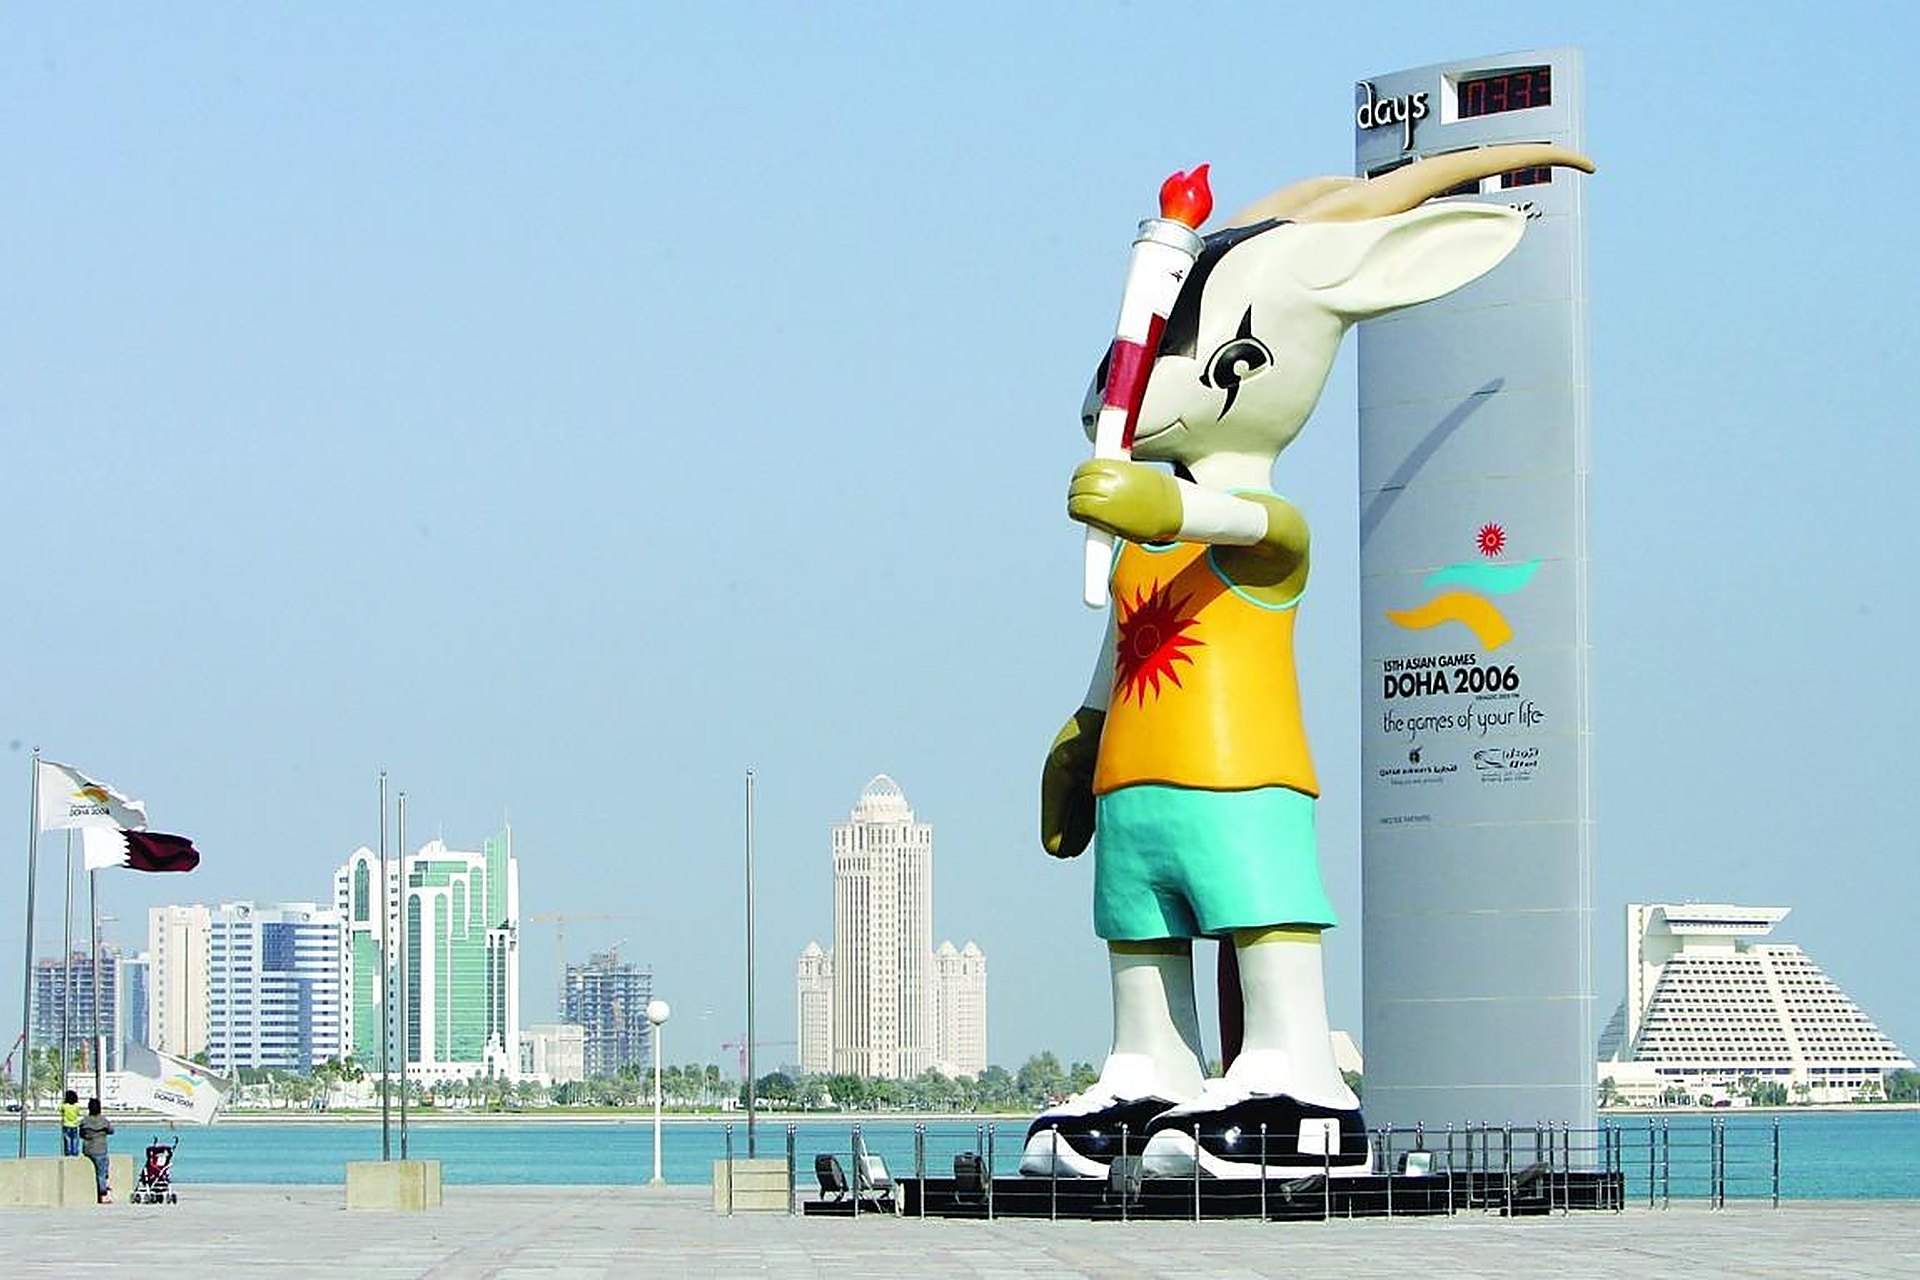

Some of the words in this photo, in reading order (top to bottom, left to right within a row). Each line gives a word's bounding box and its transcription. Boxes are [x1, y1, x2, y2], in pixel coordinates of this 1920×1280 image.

[1357, 80, 1428, 150] days
[1384, 660, 1404, 673] 15TH
[1405, 657, 1436, 671] ASIAN
[1438, 653, 1476, 668] GAMES
[1384, 671, 1449, 699] DOHA
[1454, 665, 1520, 694] 2006
[1384, 708, 1404, 733] the
[1407, 714, 1454, 743] games
[1457, 704, 1474, 731] of
[1477, 711, 1515, 737] your
[1519, 699, 1545, 728] life
